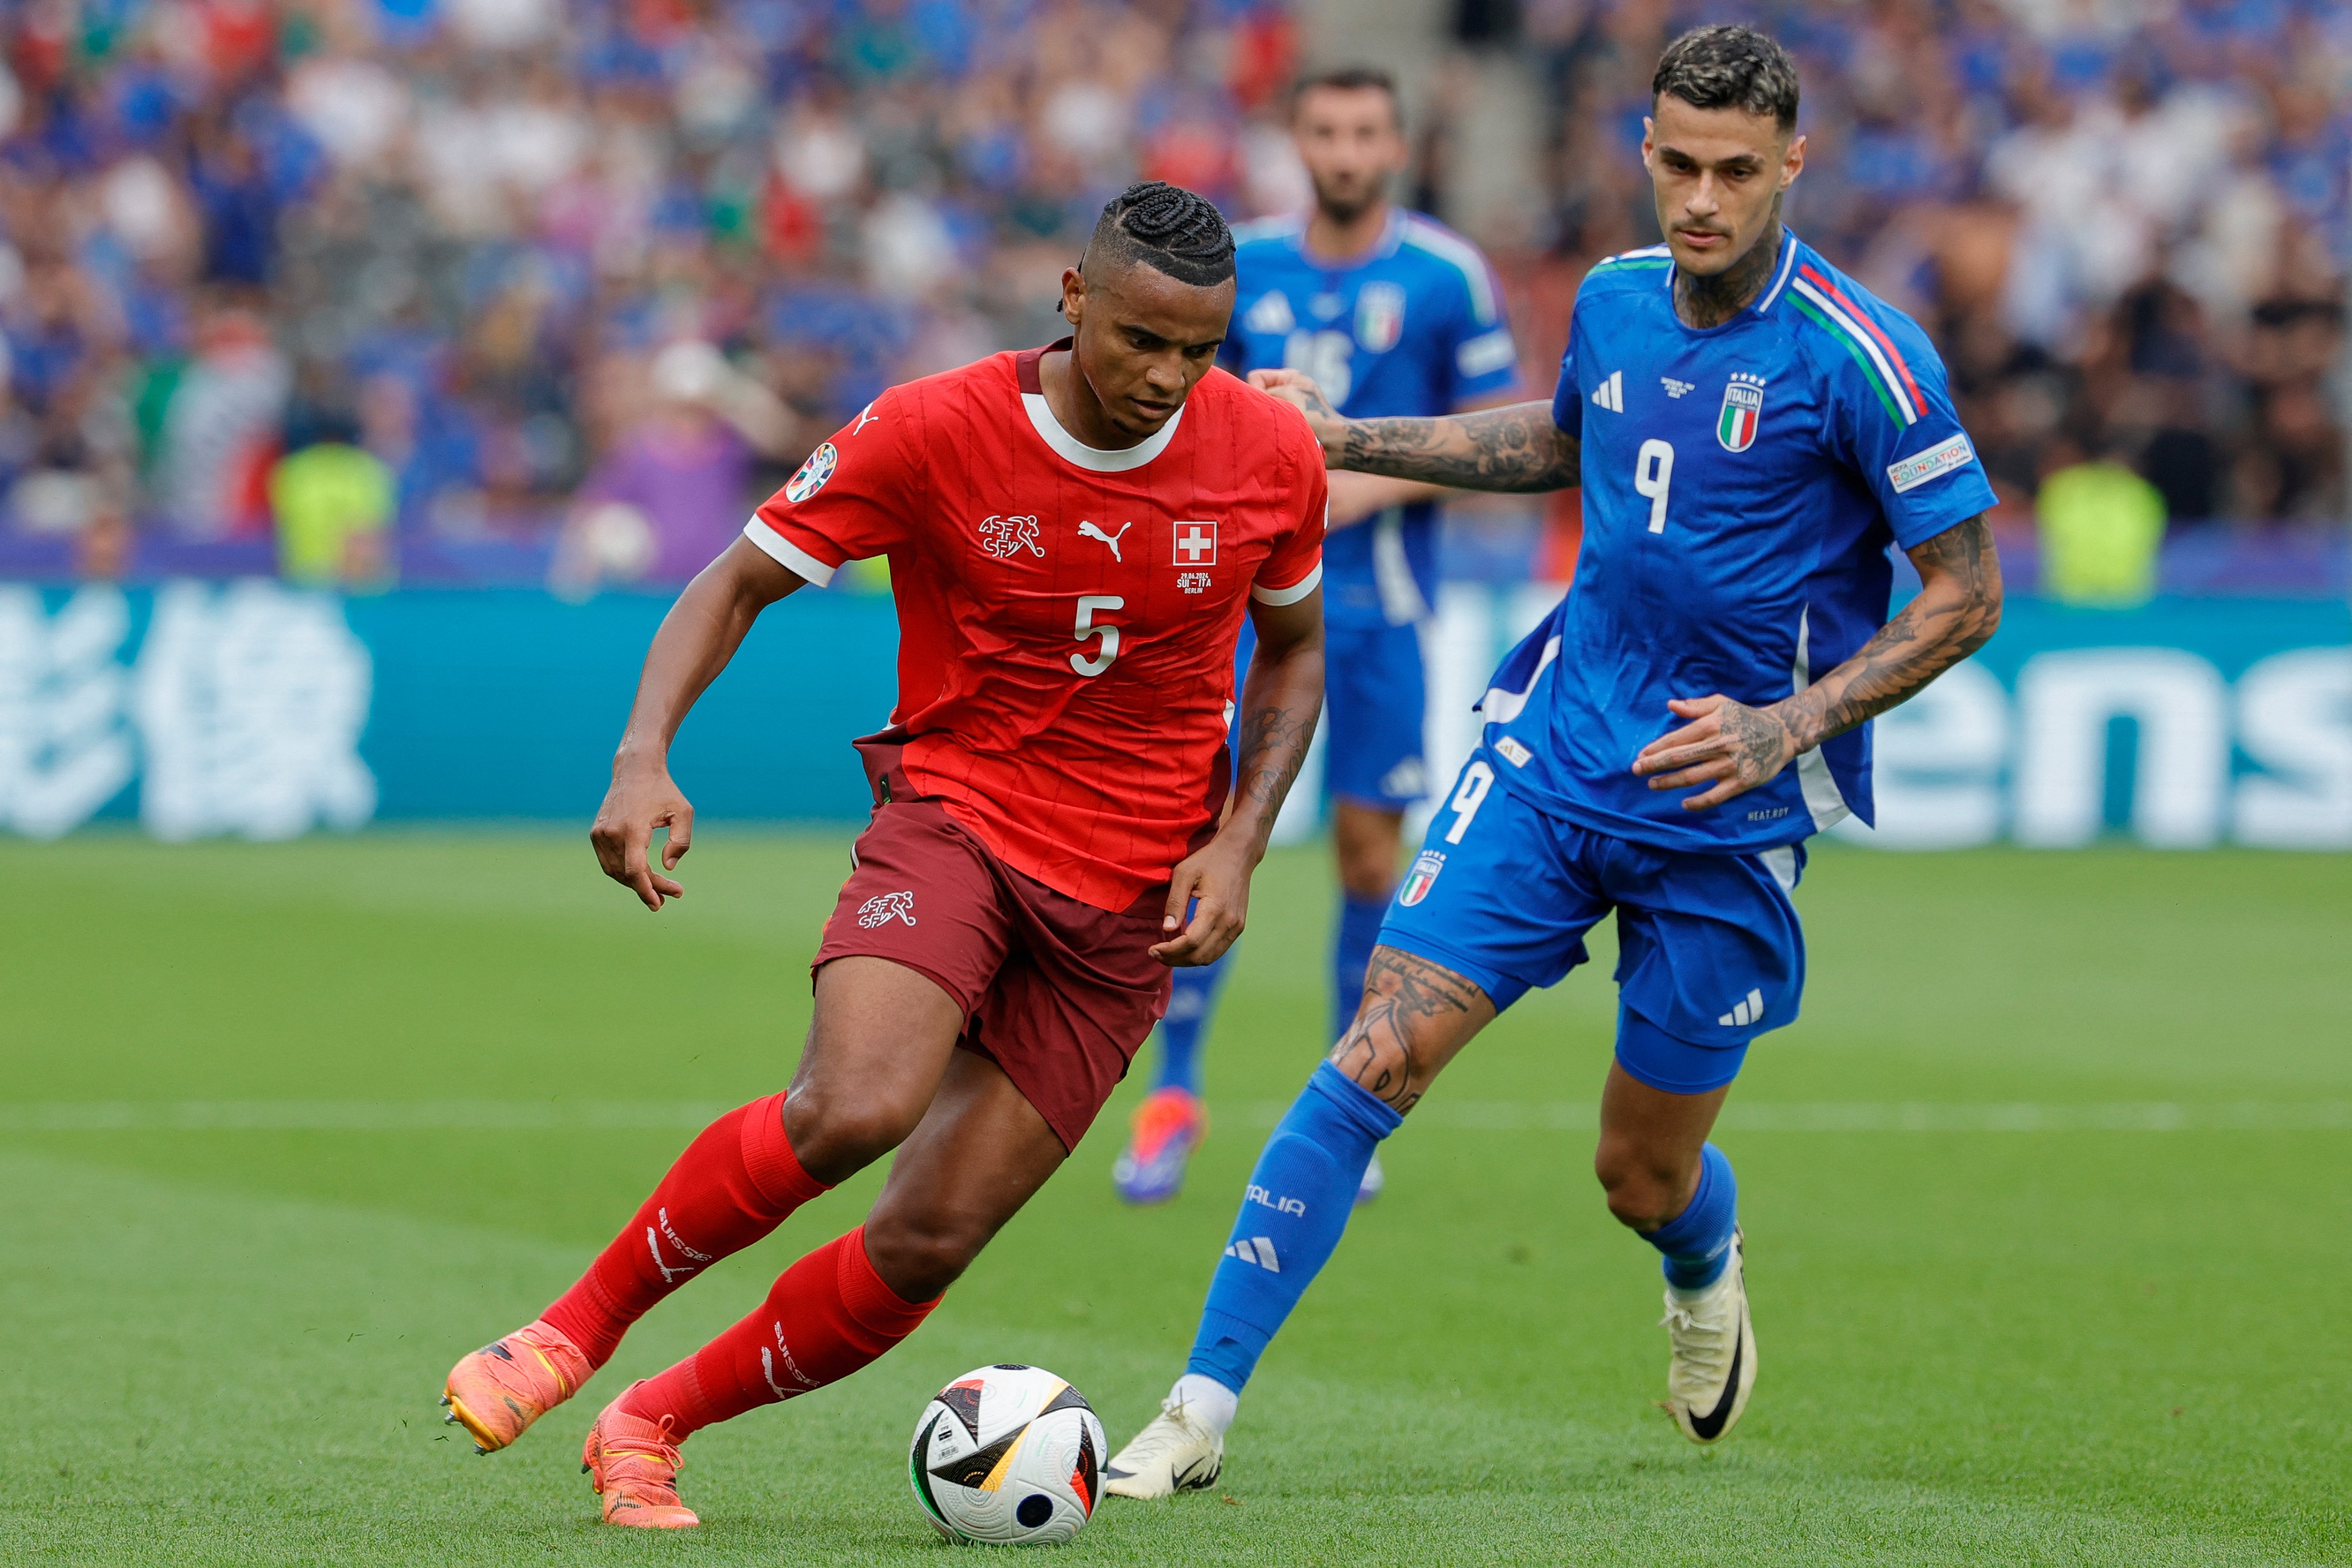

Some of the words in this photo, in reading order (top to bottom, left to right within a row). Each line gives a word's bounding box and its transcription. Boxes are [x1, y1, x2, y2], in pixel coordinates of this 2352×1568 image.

[1728, 388, 1759, 406] ITALIA
[1634, 438, 1675, 535] 9
[1893, 443, 1967, 485] FOUNDATION
[1177, 578, 1190, 588] SUI
[1198, 578, 1211, 587] ITA
[1070, 595, 1124, 677] 5
[1445, 760, 1495, 845] 9
[1245, 1184, 1306, 1218] TALIA
[659, 1207, 712, 1261] SUISSE
[775, 1321, 820, 1387] SUISSE
